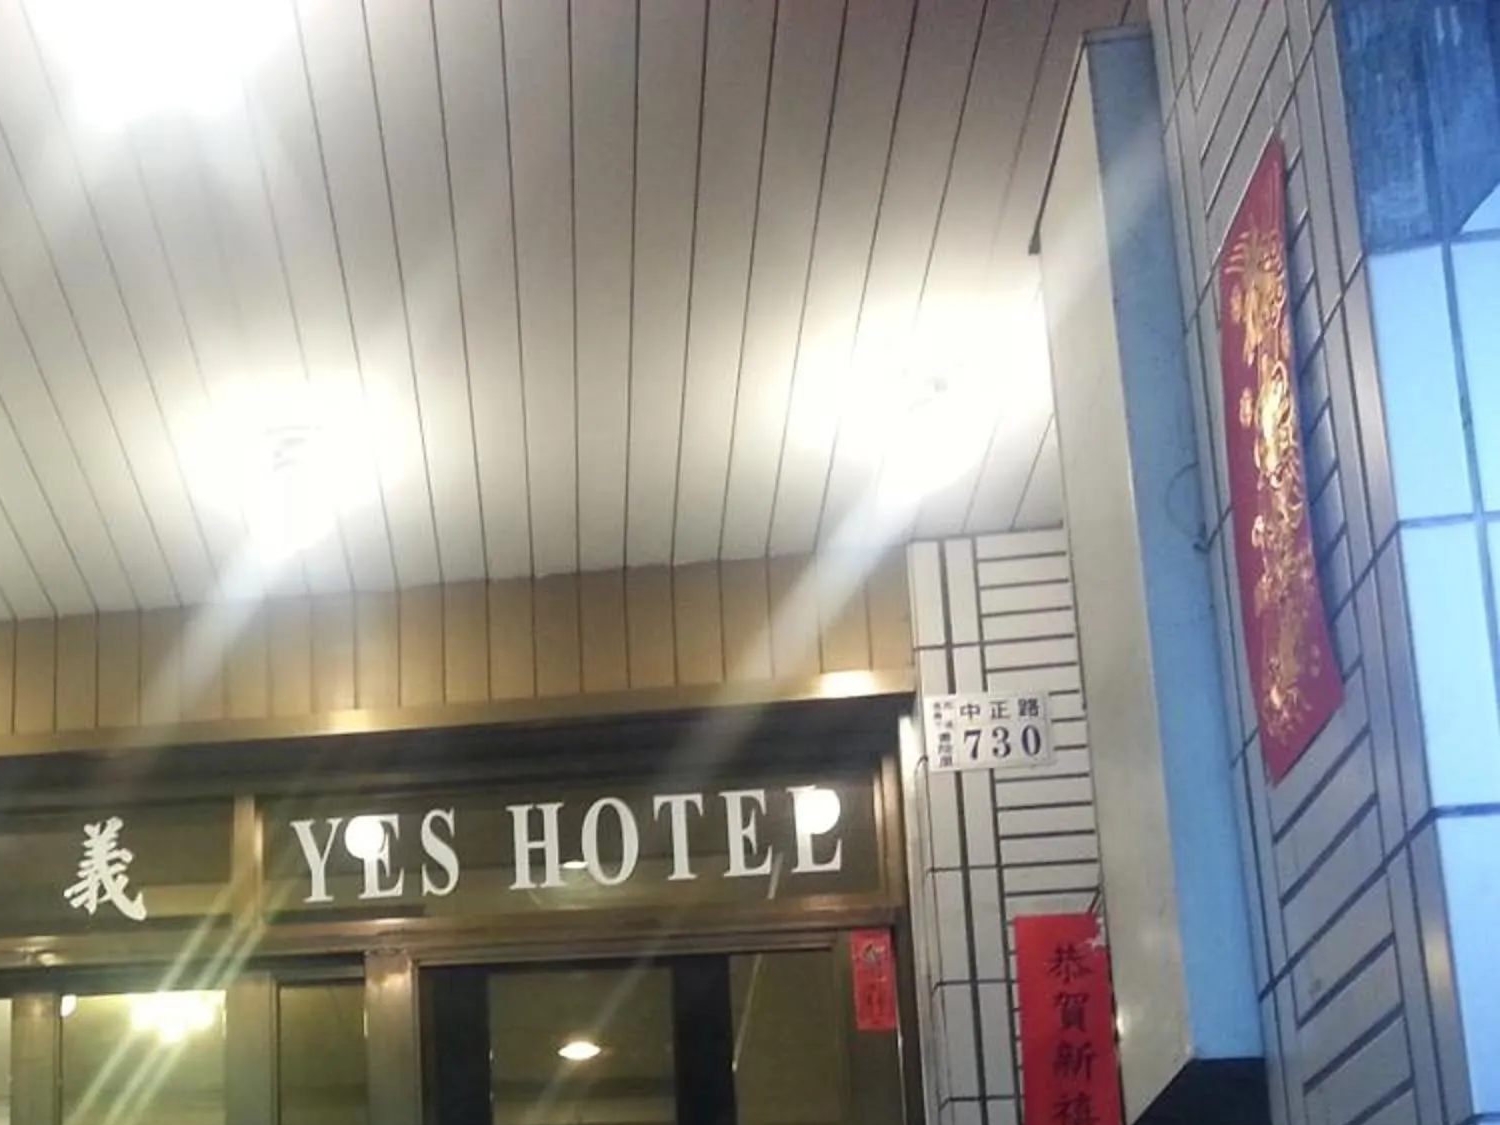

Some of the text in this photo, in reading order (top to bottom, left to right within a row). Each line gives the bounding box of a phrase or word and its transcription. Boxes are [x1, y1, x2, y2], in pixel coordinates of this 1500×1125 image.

[960, 697, 1040, 719] 中正路
[963, 724, 1041, 760] 730
[290, 785, 844, 903] YES HOTEL
